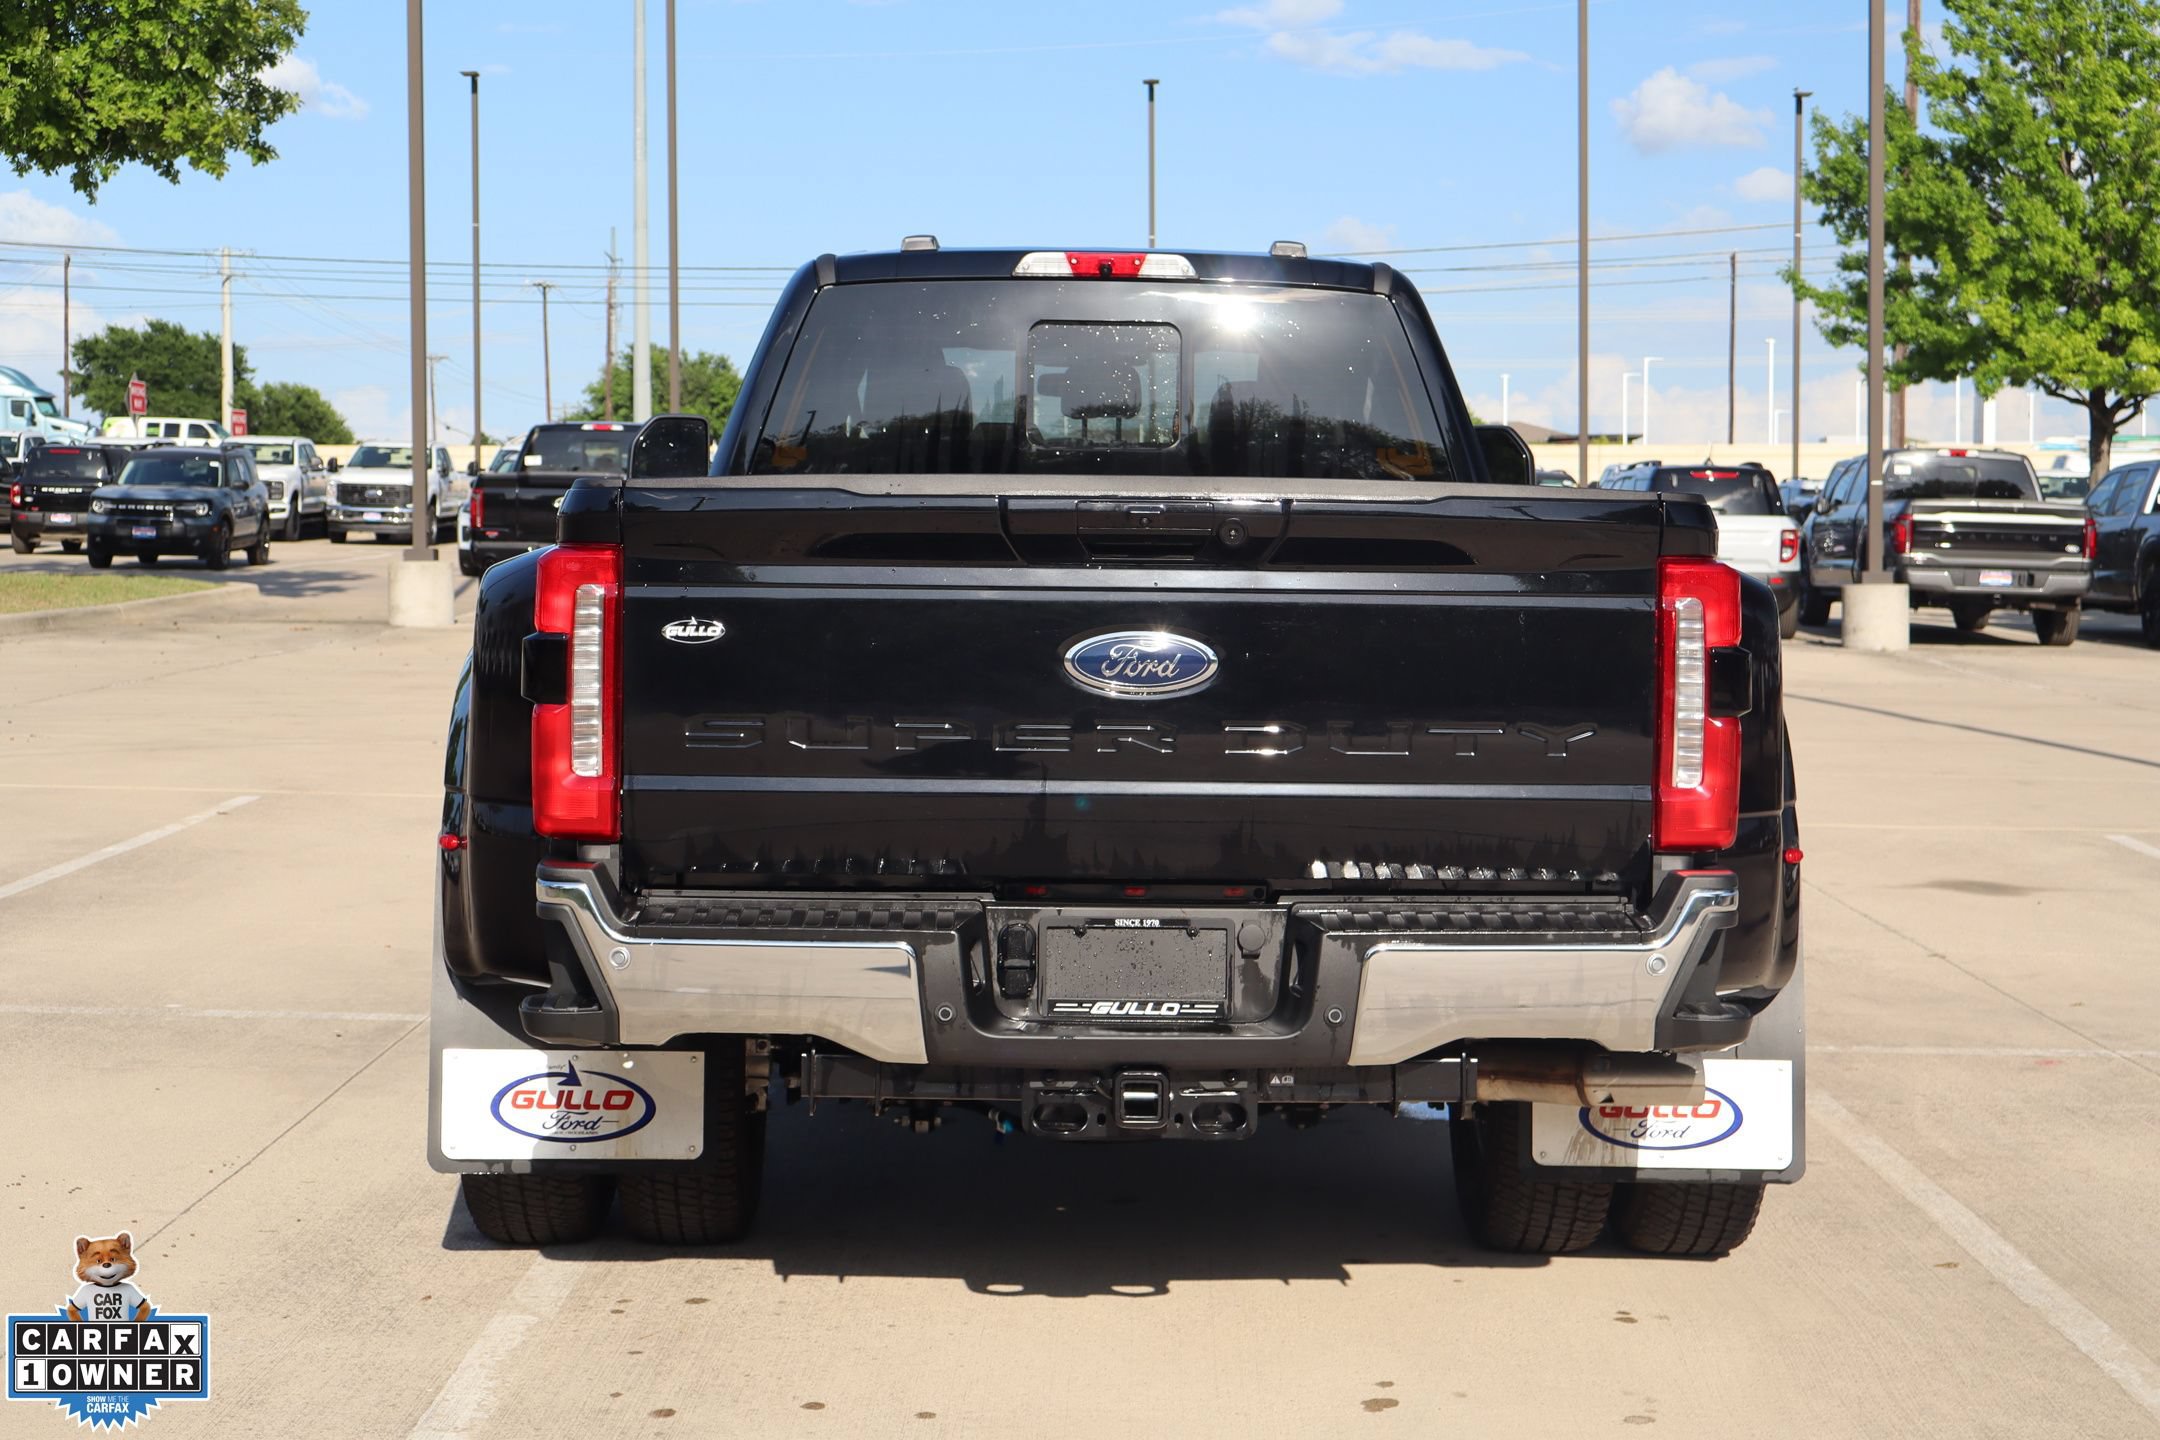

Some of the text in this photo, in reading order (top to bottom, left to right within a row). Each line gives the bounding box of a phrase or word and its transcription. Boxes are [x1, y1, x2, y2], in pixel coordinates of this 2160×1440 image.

[665, 625, 722, 637] GULLO
[1100, 641, 1182, 679] Ford
[684, 713, 1599, 758] SUPER DUTY
[1114, 918, 1140, 928] SINCE
[1089, 1001, 1181, 1016] GULLO
[510, 1089, 635, 1111] GULLO
[542, 1110, 602, 1131] Ford
[1630, 1119, 1692, 1139] Ford
